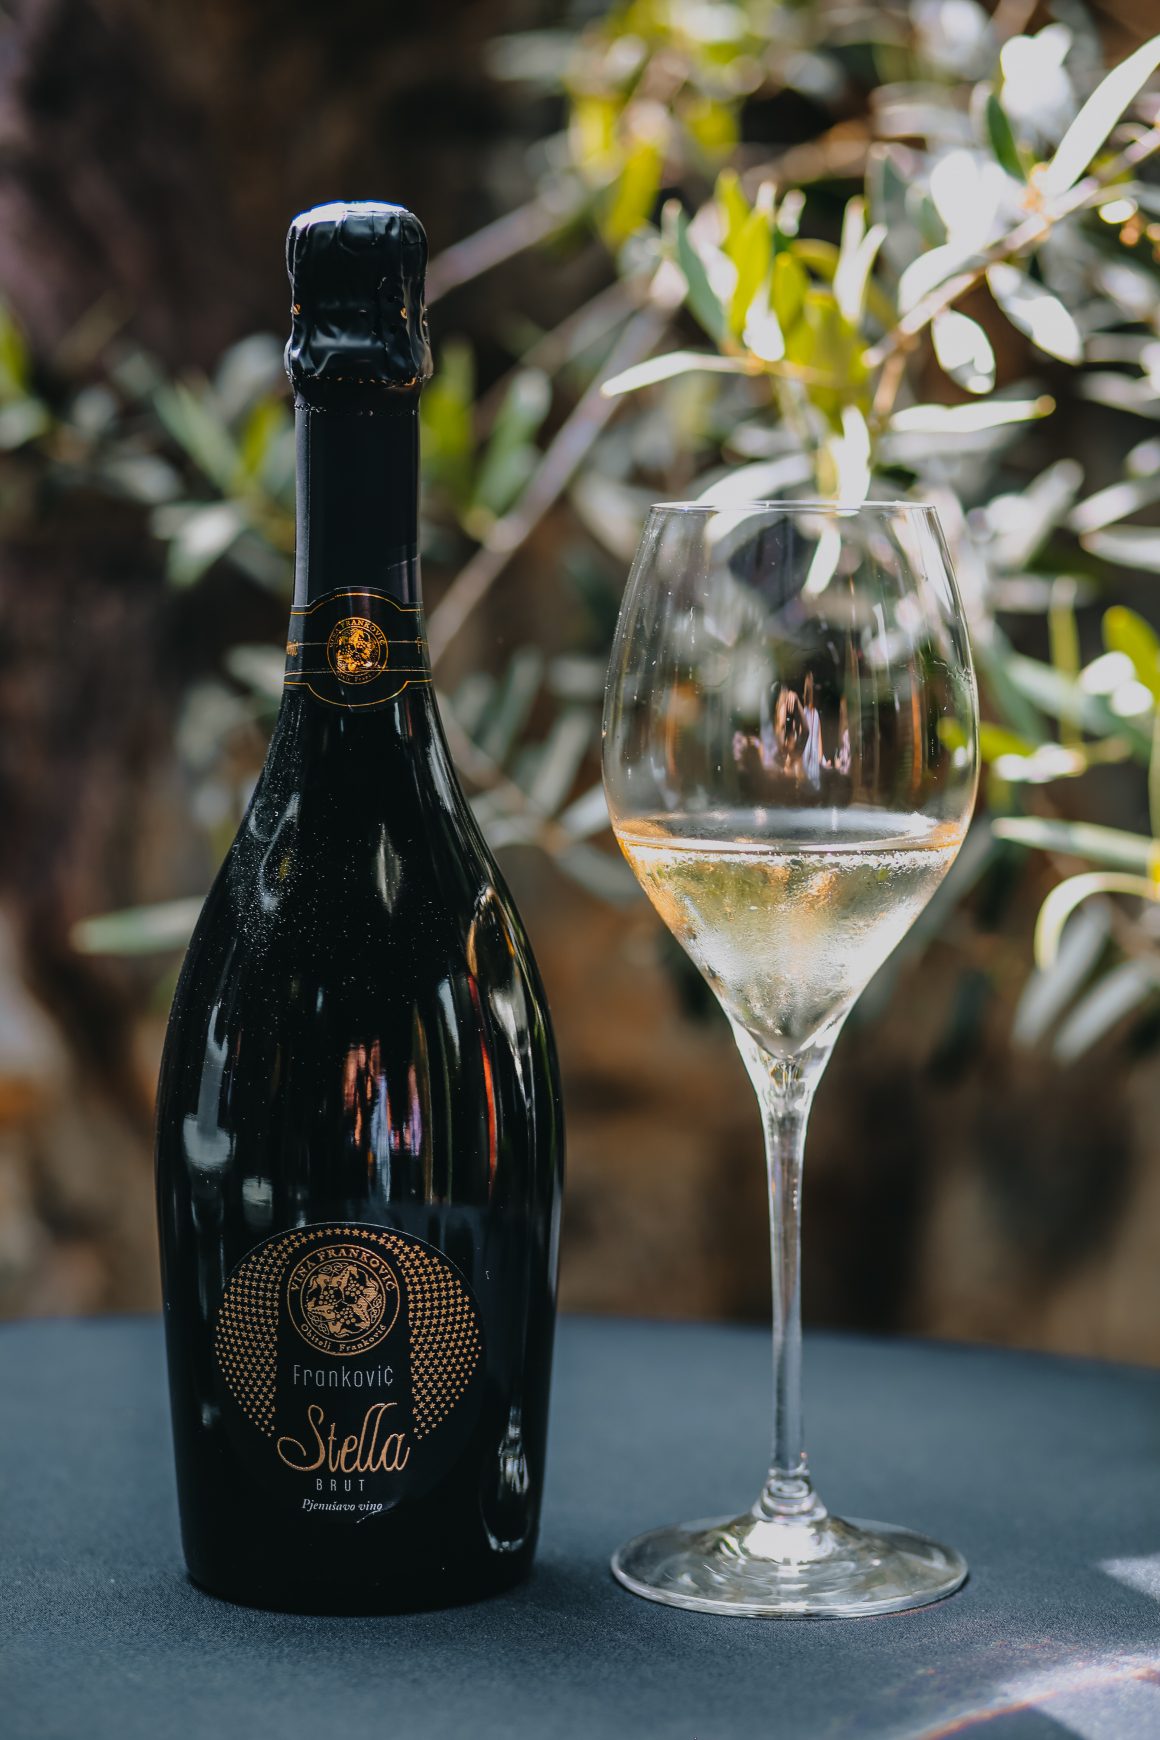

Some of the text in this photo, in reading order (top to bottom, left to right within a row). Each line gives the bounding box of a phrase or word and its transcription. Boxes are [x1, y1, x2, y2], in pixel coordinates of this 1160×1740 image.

[291, 1248, 396, 1291] VINA FRANKOVIĆ
[300, 1322, 332, 1351] Obitelj
[277, 1402, 411, 1473] Stella
[316, 1478, 365, 1492] BRUT
[302, 1499, 383, 1512] Pjenušavo vino
